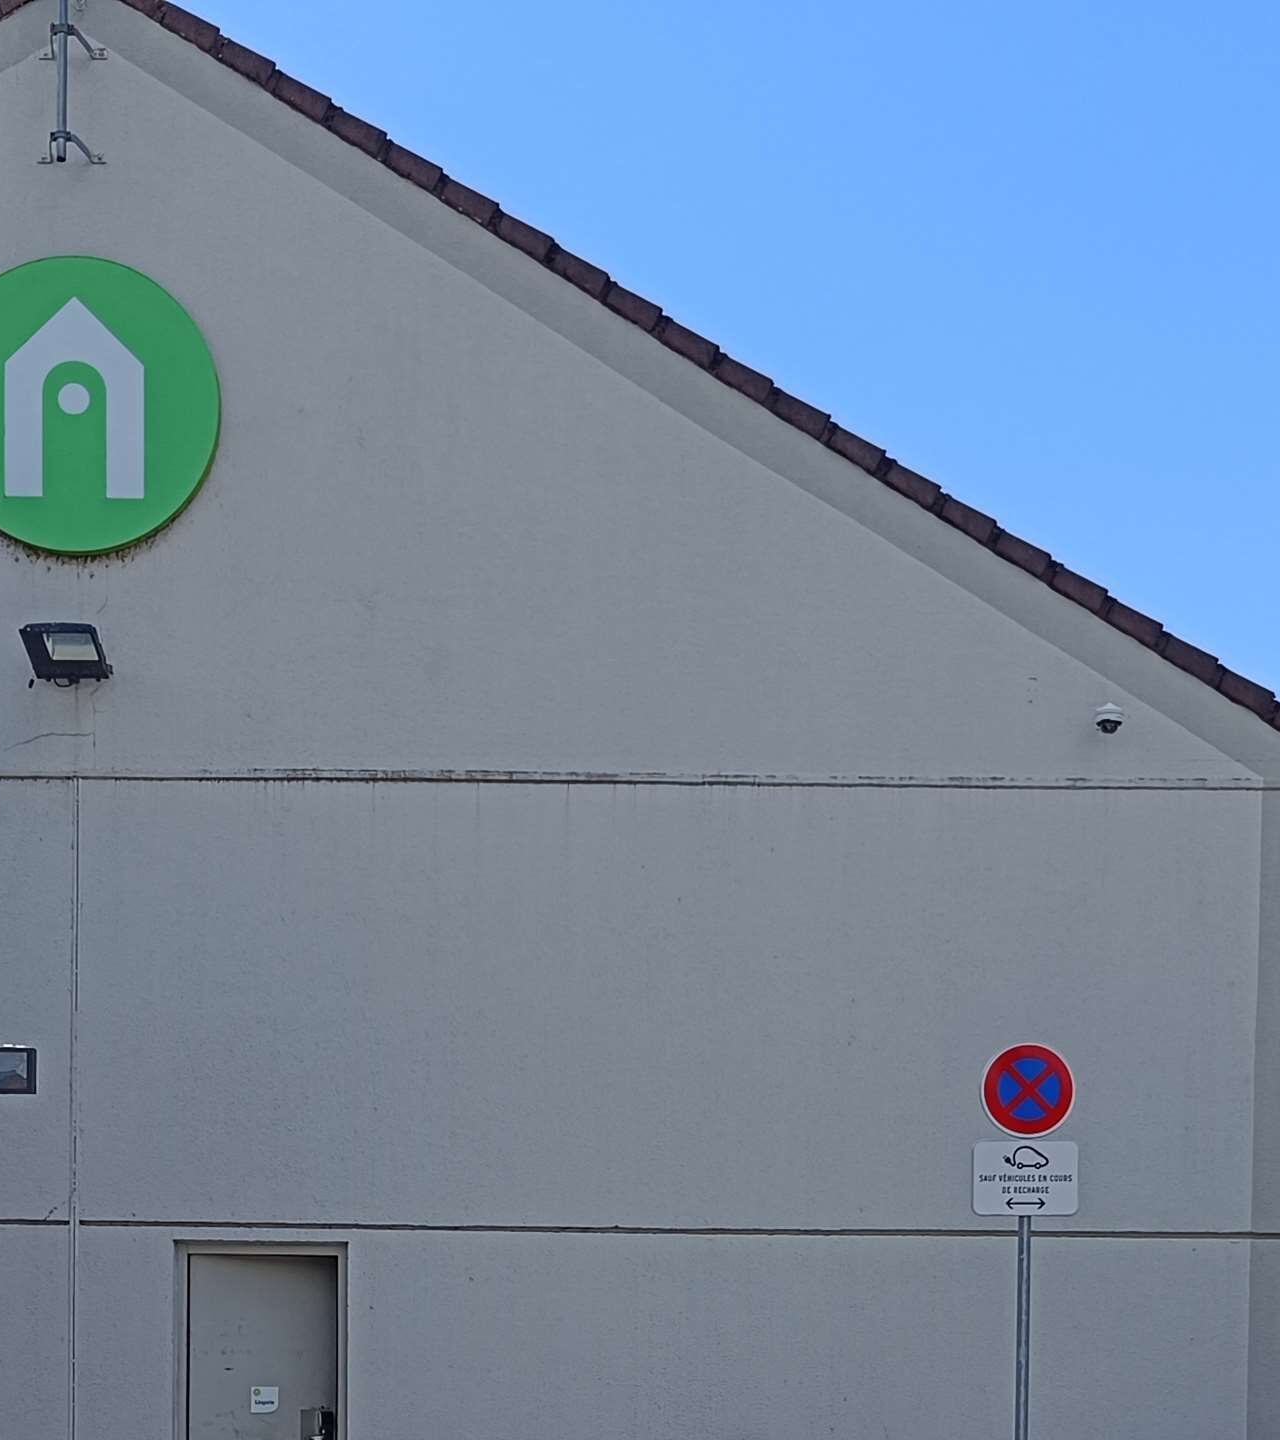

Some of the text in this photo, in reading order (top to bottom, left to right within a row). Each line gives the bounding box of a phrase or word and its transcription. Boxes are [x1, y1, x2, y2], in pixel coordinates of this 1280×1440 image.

[979, 1172, 1073, 1183] SAUF VÉHICULES EN COURS
[1001, 1186, 1050, 1194] DE RECHARGE
